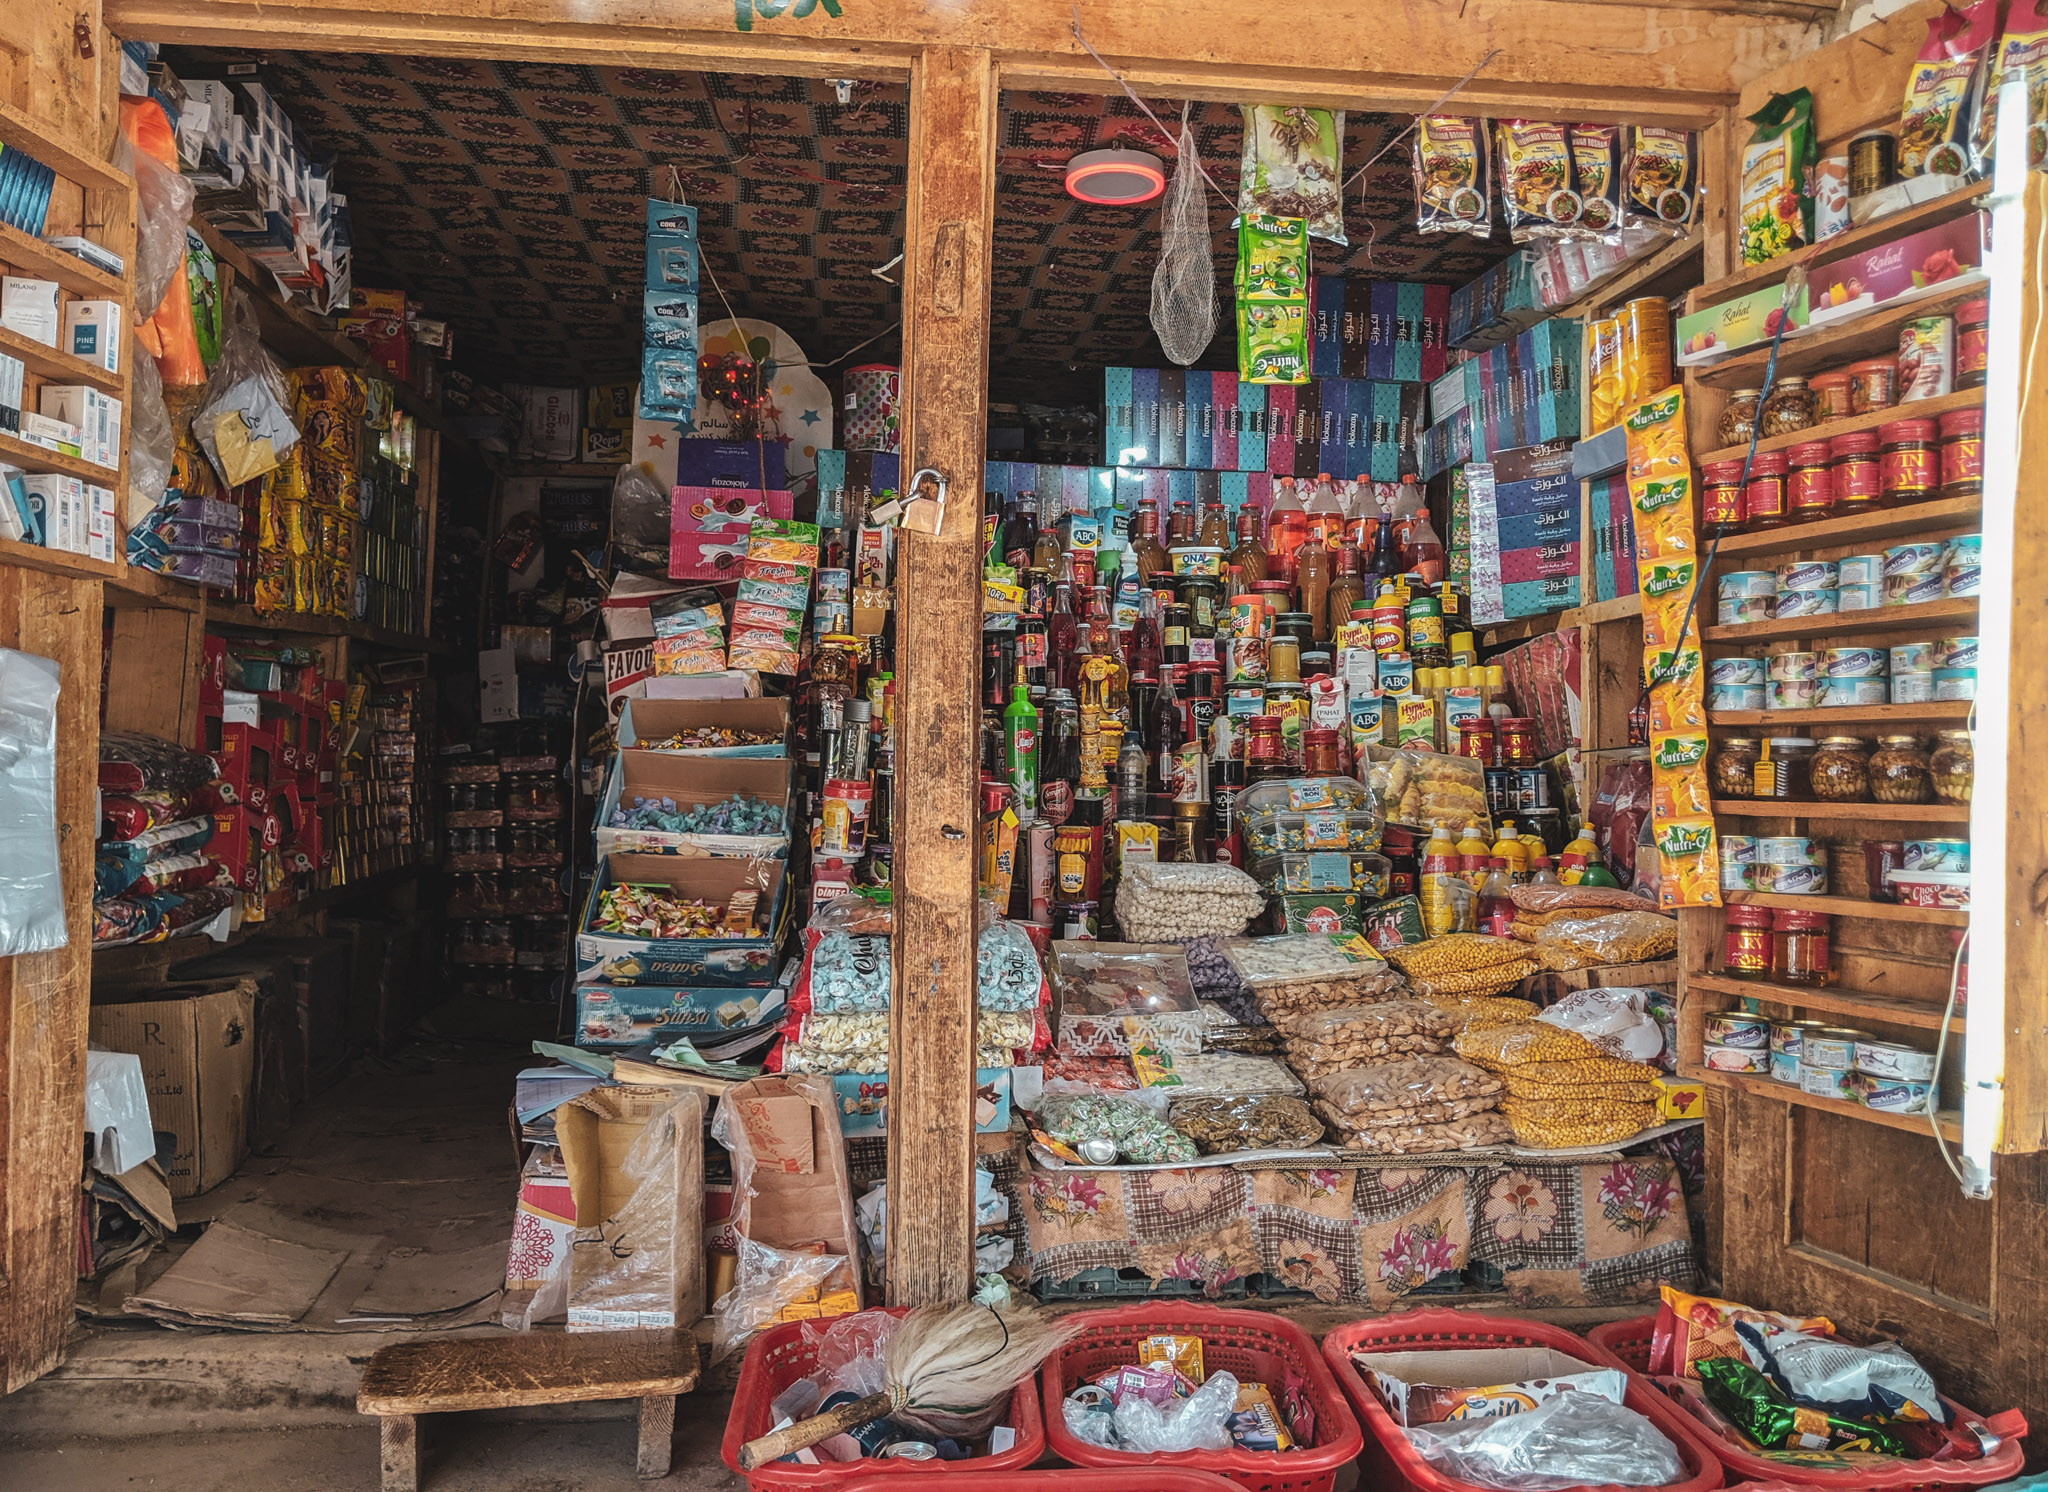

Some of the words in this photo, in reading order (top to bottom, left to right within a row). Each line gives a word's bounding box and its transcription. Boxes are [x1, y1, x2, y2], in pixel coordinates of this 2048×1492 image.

[659, 221, 675, 229] COOL
[1255, 219, 1299, 236] Nutri-C
[1867, 246, 1904, 273] Rahat
[9, 282, 37, 291] MILANO
[657, 307, 675, 317] COOL
[1722, 301, 1752, 323] Rahat
[75, 336, 95, 345] PINE
[1256, 356, 1300, 371] Nutri-C
[1552, 355, 1563, 399] Alokozay
[1521, 369, 1529, 411] Alokozay
[1123, 399, 1132, 434] Alokozay
[1149, 400, 1158, 436] Alokozay
[1176, 401, 1185, 437] Alokozay
[1201, 402, 1211, 438] Alokozay
[1228, 402, 1237, 438] Alokozay
[1254, 404, 1264, 440] Alokozay
[1269, 406, 1280, 442] Alokozay
[1295, 408, 1306, 445] Alokozay
[1321, 410, 1332, 446] Alokozay
[1347, 412, 1358, 449] Alokozay
[1373, 414, 1384, 450] Alokozay
[1399, 416, 1409, 452] Alokozay
[589, 433, 621, 450] Rops
[711, 477, 749, 489] Alokozay
[834, 482, 843, 520] Alokozay
[1641, 486, 1683, 509] Nutri-C
[1075, 530, 1095, 542] ABC
[1182, 553, 1206, 565] ONA
[758, 565, 786, 578] Fresh
[1649, 571, 1688, 593] Nutri-C
[755, 586, 782, 598] Fresh
[750, 607, 777, 620] Fresh
[671, 635, 696, 651] Fresh
[747, 631, 774, 641] Fresh
[673, 654, 699, 670] Fresh
[1384, 676, 1409, 687] ABC
[1316, 709, 1340, 717] ГРАНАТ
[1356, 714, 1378, 726] ABC
[1660, 748, 1701, 765] Nutri-C
[1302, 785, 1320, 793] MILKY
[1665, 835, 1707, 853] Nutri-C
[1570, 863, 1585, 871] Dish
[1912, 884, 1941, 902] Choco
[654, 1008, 709, 1026] Sansa
[141, 1021, 166, 1047] R
